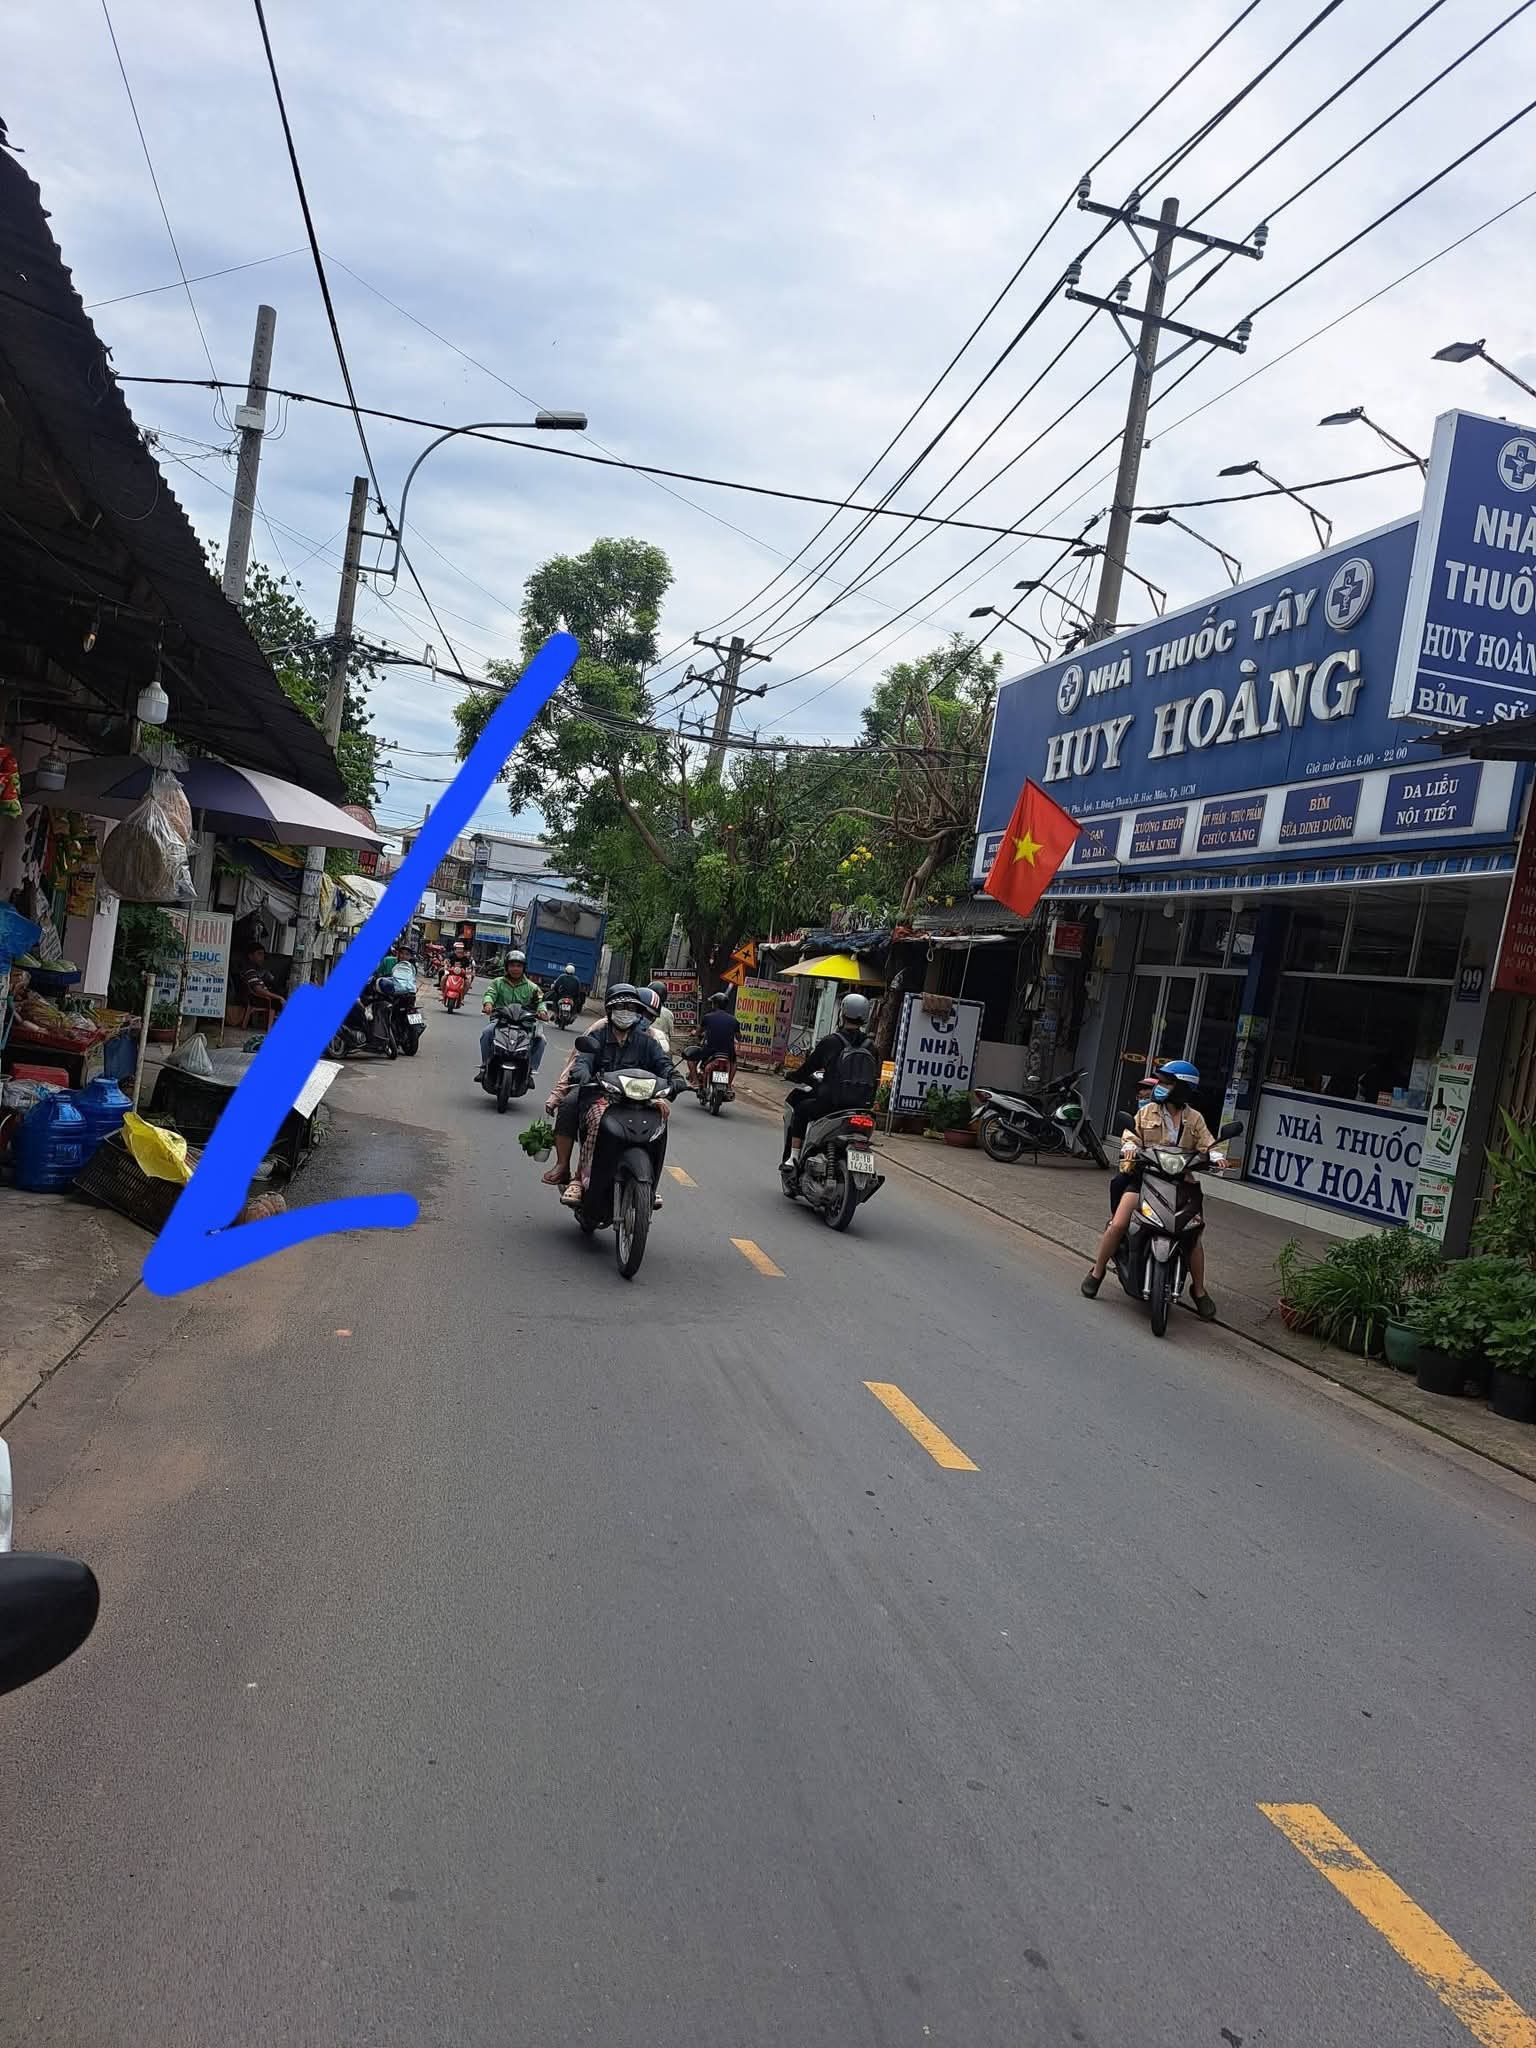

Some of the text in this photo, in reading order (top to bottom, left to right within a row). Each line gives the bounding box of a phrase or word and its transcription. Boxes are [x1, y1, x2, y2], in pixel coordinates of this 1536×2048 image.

[1473, 504, 1536, 556] NHÀ
[1445, 559, 1536, 615] THUỐ
[1086, 587, 1320, 697] NHÀ THUỐC TÂY
[1422, 623, 1474, 663] HUY
[1417, 682, 1468, 718] BỈM
[1042, 649, 1364, 783] HUY HOÀNG
[1322, 757, 1335, 772] mở
[1402, 773, 1459, 800] DA LIỄU
[1308, 794, 1330, 812] BỈM
[1395, 800, 1457, 826] NỘI TIẾT
[1201, 827, 1255, 846] CHỨC NĂNG
[1281, 813, 1353, 838] SỮA DINH DƯỠNG
[1156, 837, 1177, 851] KINH
[1461, 968, 1483, 991] 99
[920, 1038, 960, 1056] NHÀ
[906, 1058, 969, 1080] THUỐC
[1276, 1113, 1323, 1145] NHÀ
[1336, 1126, 1423, 1168] THUỐC
[1251, 1144, 1315, 1188] HUY
